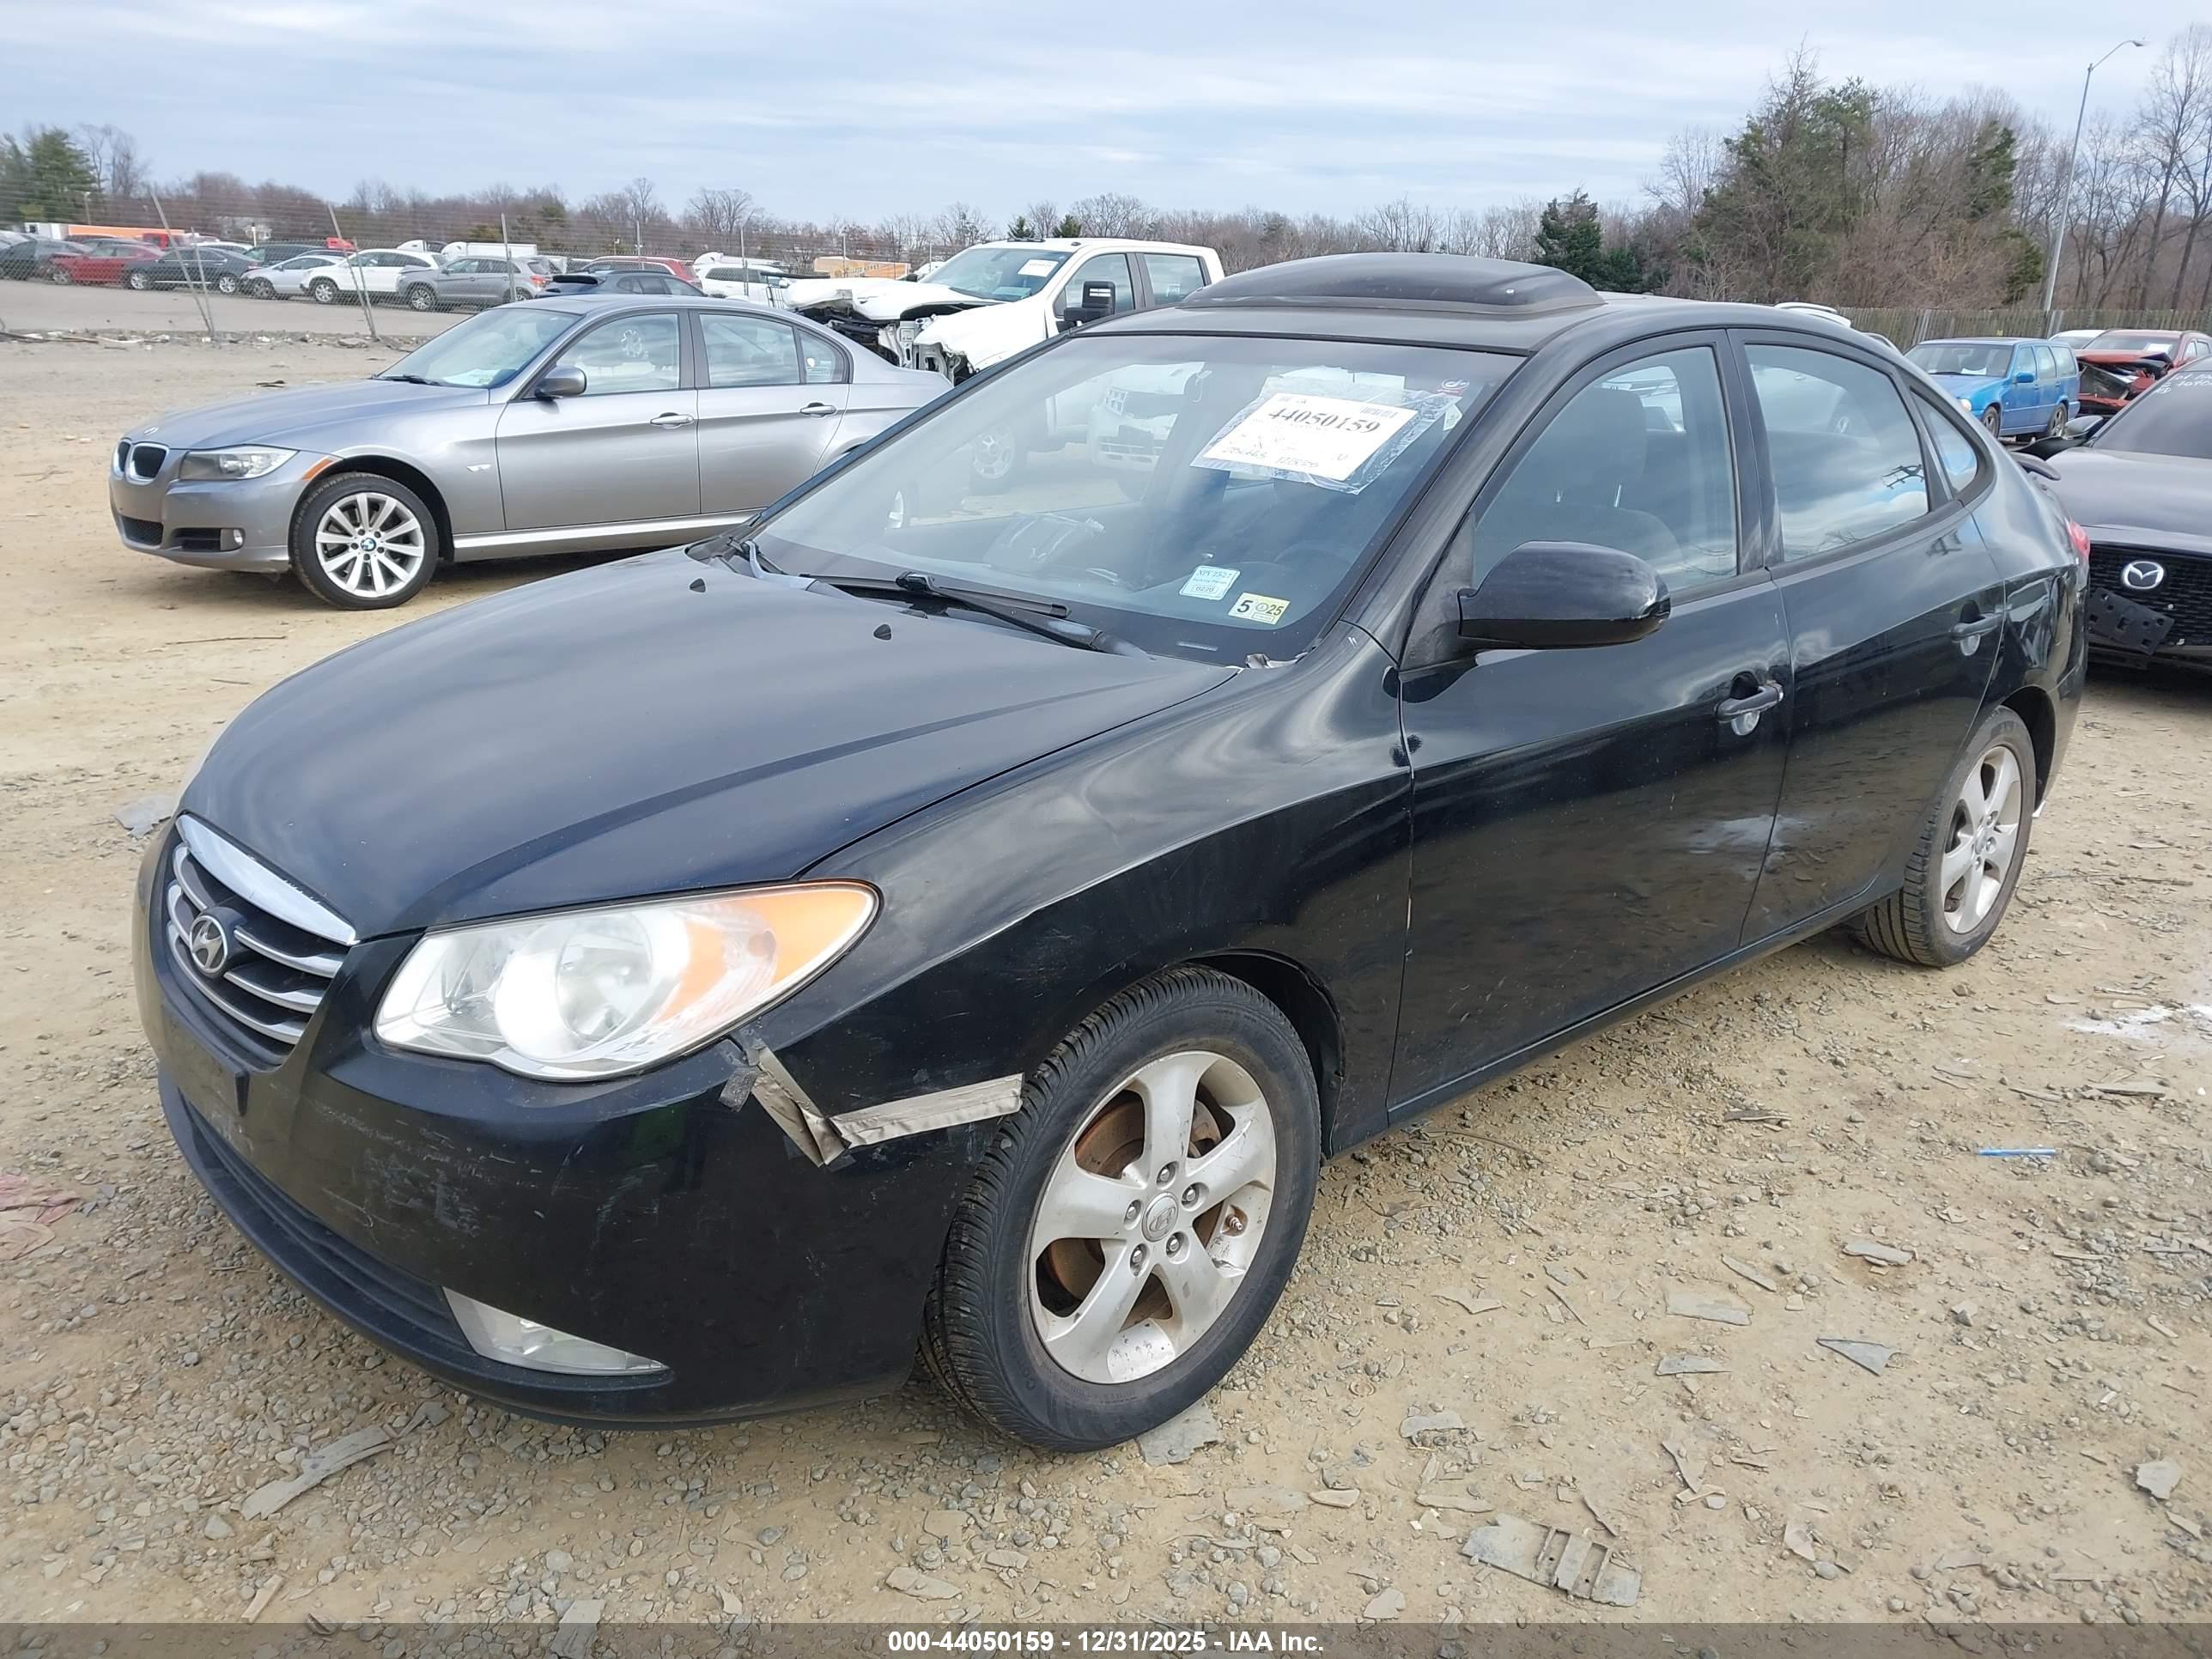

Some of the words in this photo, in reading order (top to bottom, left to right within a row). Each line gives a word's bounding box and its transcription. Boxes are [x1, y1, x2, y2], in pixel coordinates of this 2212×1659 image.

[1269, 407, 1381, 433] 44050159
[1237, 599, 1254, 612] 5
[1266, 605, 1284, 616] 25
